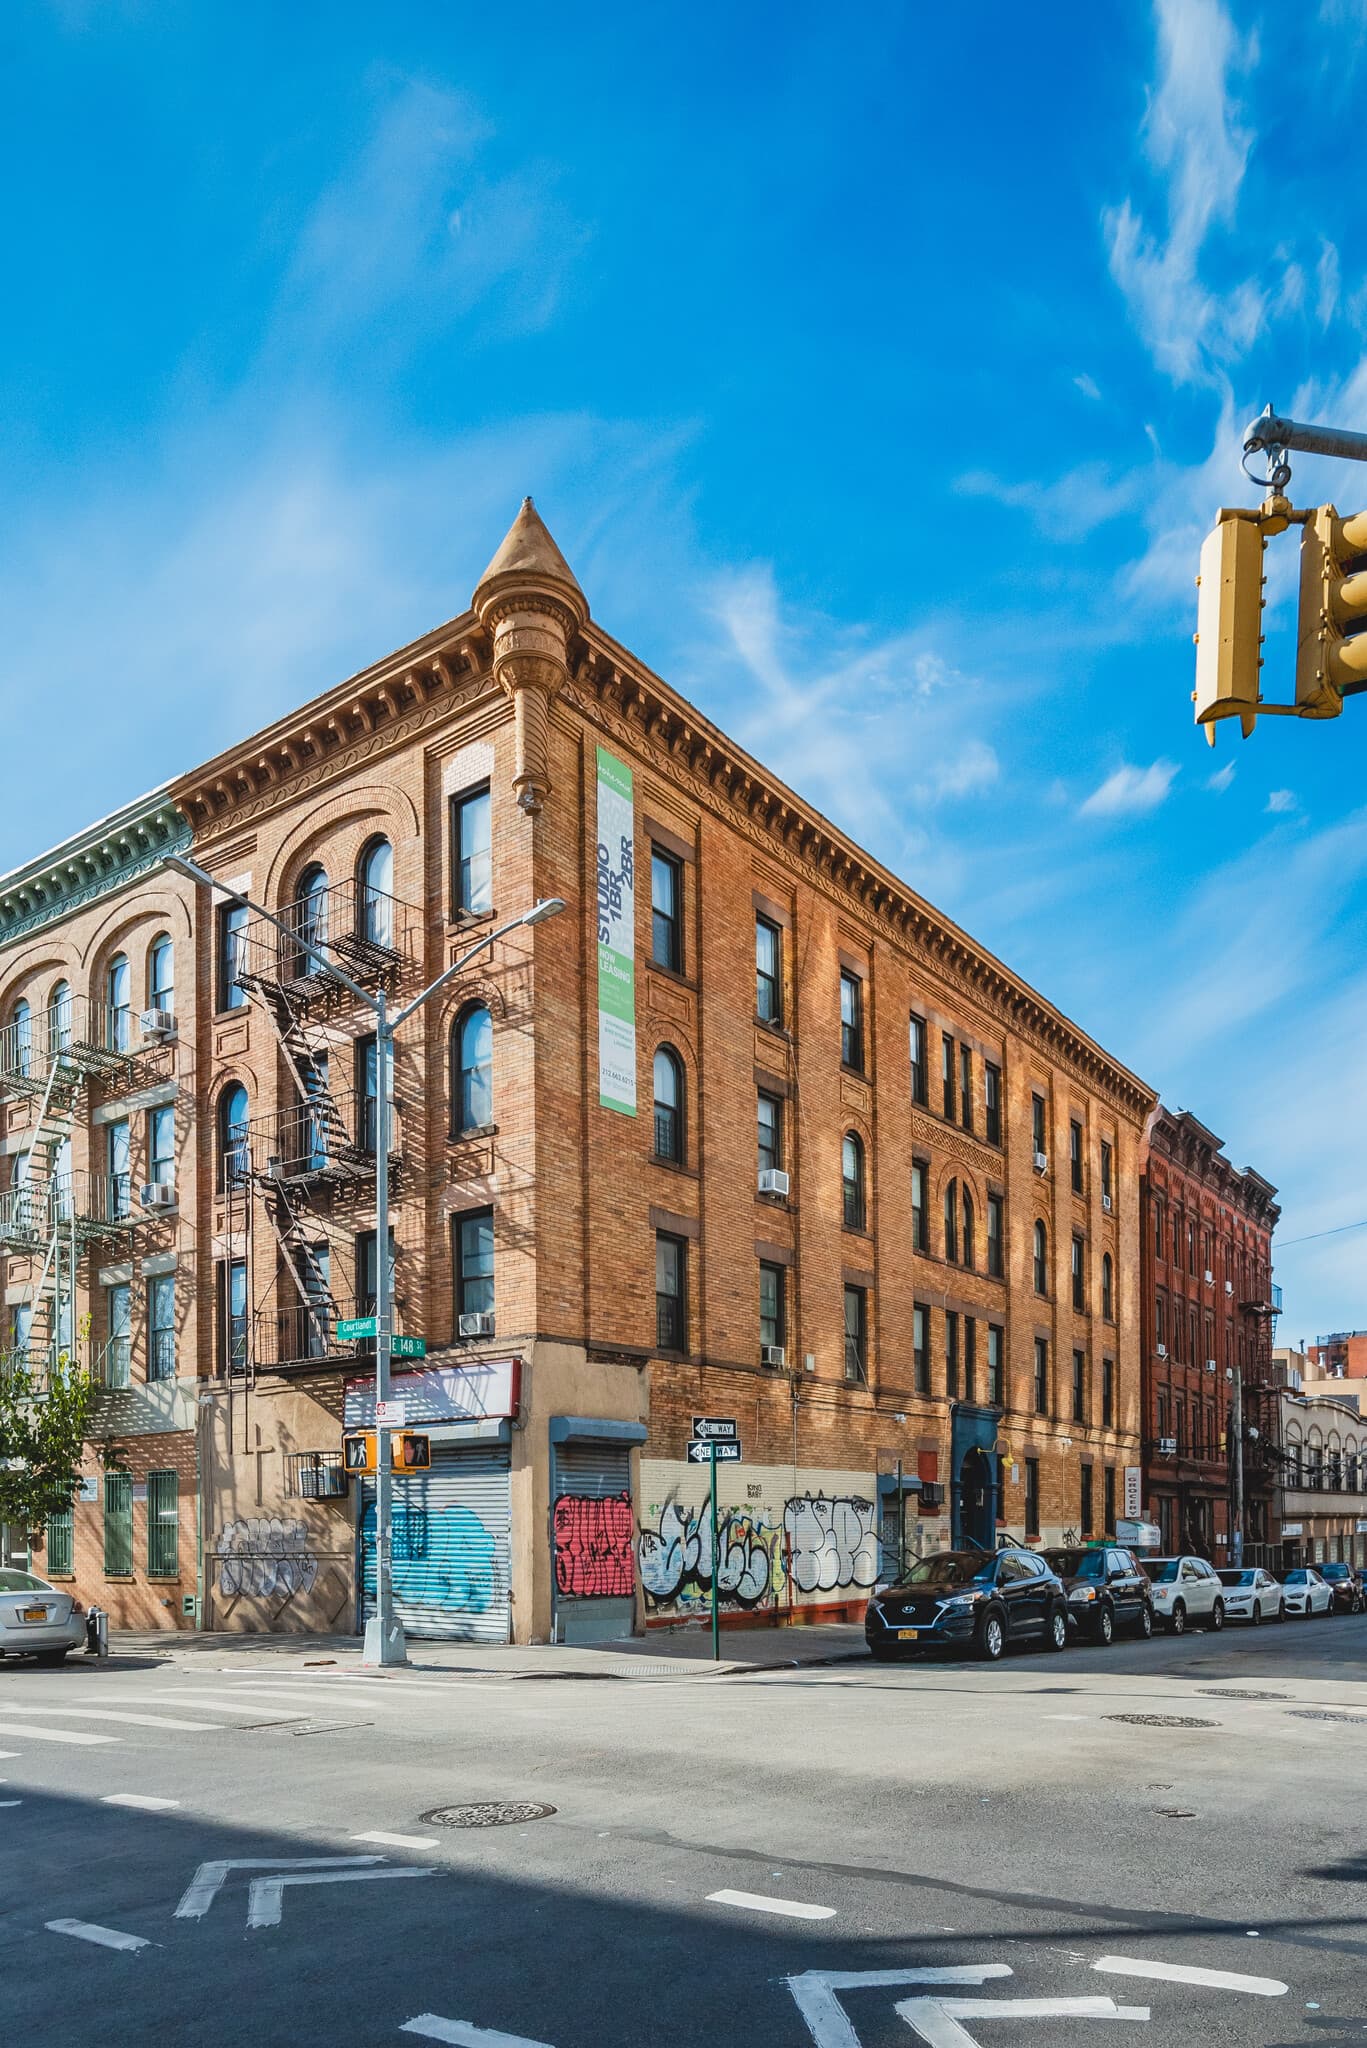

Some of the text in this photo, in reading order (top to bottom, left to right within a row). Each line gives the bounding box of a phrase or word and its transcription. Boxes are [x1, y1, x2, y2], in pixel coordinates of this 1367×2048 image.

[621, 835, 632, 890] 2BR
[597, 843, 610, 945] STUDIO
[609, 870, 621, 921] 1BR
[599, 948, 615, 964] NOW
[599, 959, 631, 984] LEASING
[342, 1320, 372, 1331] Courtlandt
[392, 1337, 397, 1351] E
[400, 1339, 413, 1353] 148
[700, 1424, 731, 1433] ONE WAY
[695, 1447, 735, 1456] ONE WAY
[1128, 1477, 1137, 1515] GROCERY
